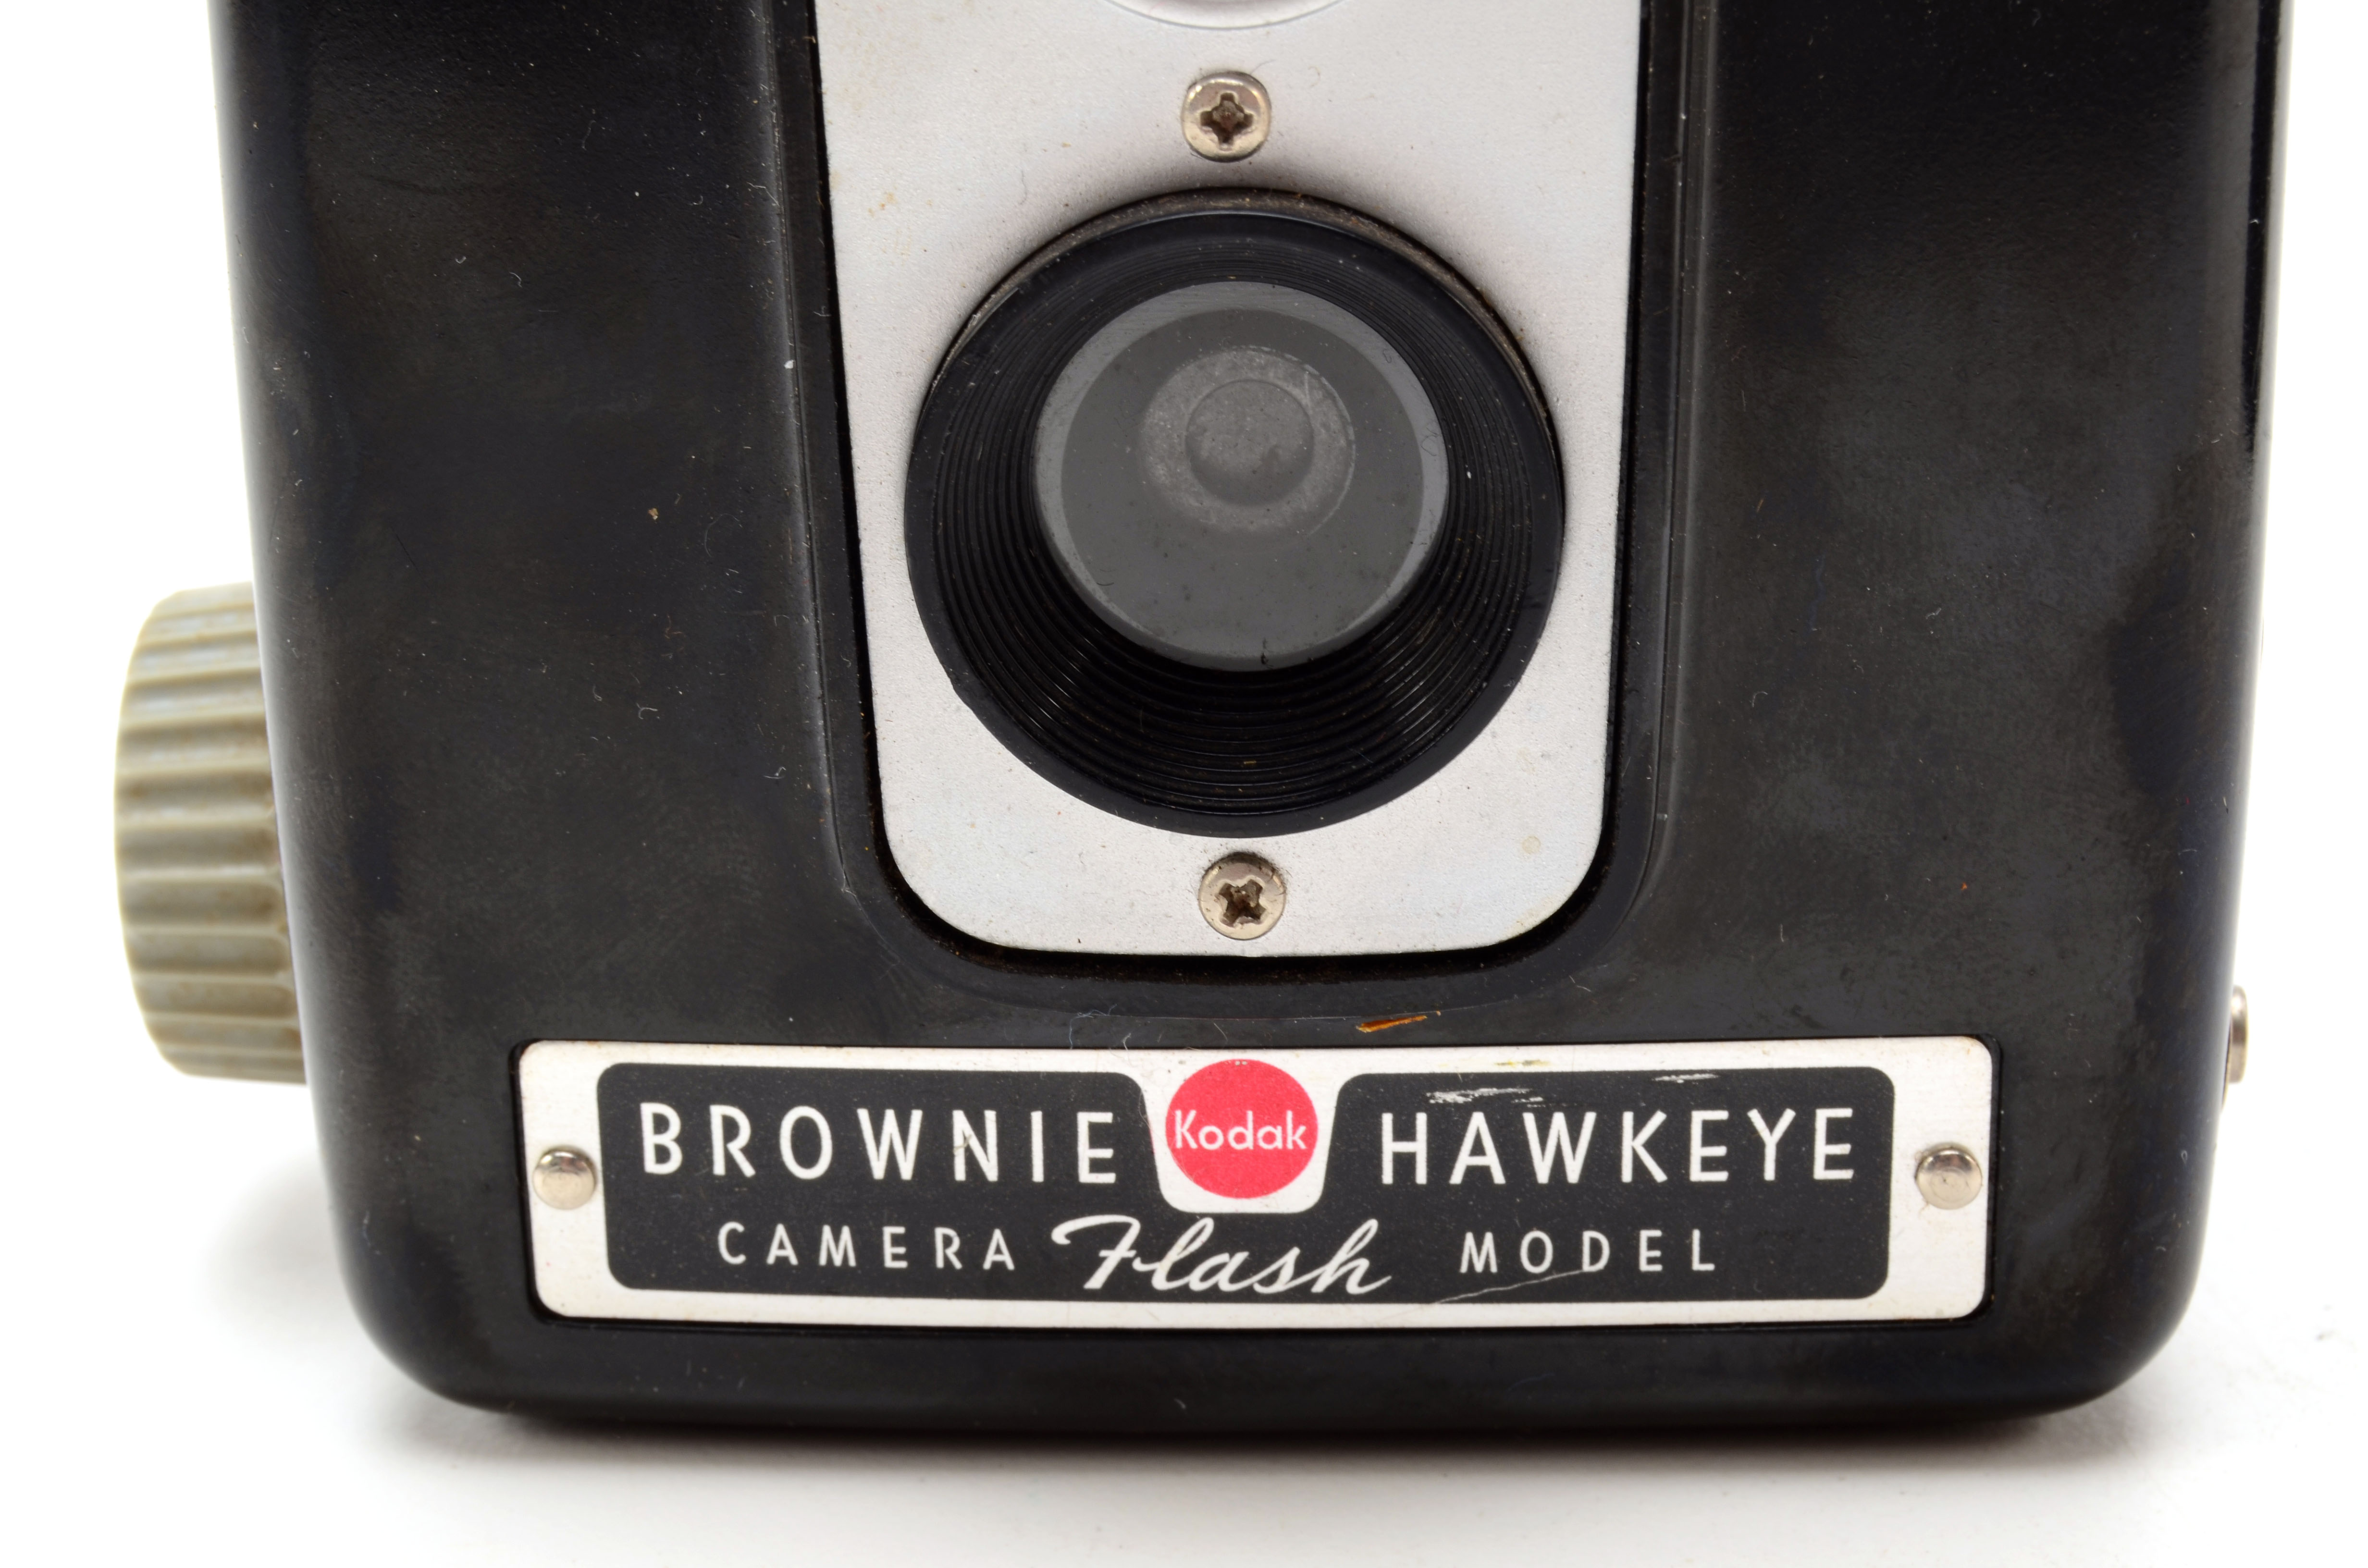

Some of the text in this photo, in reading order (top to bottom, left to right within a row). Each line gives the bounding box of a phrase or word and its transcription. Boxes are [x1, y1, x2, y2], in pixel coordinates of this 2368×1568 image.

[640, 1102, 1854, 1185] BROWNIE HAWKEYE
[1174, 1109, 1307, 1151] Kodak
[717, 1215, 1715, 1295] CAMERA Flash MODEL
